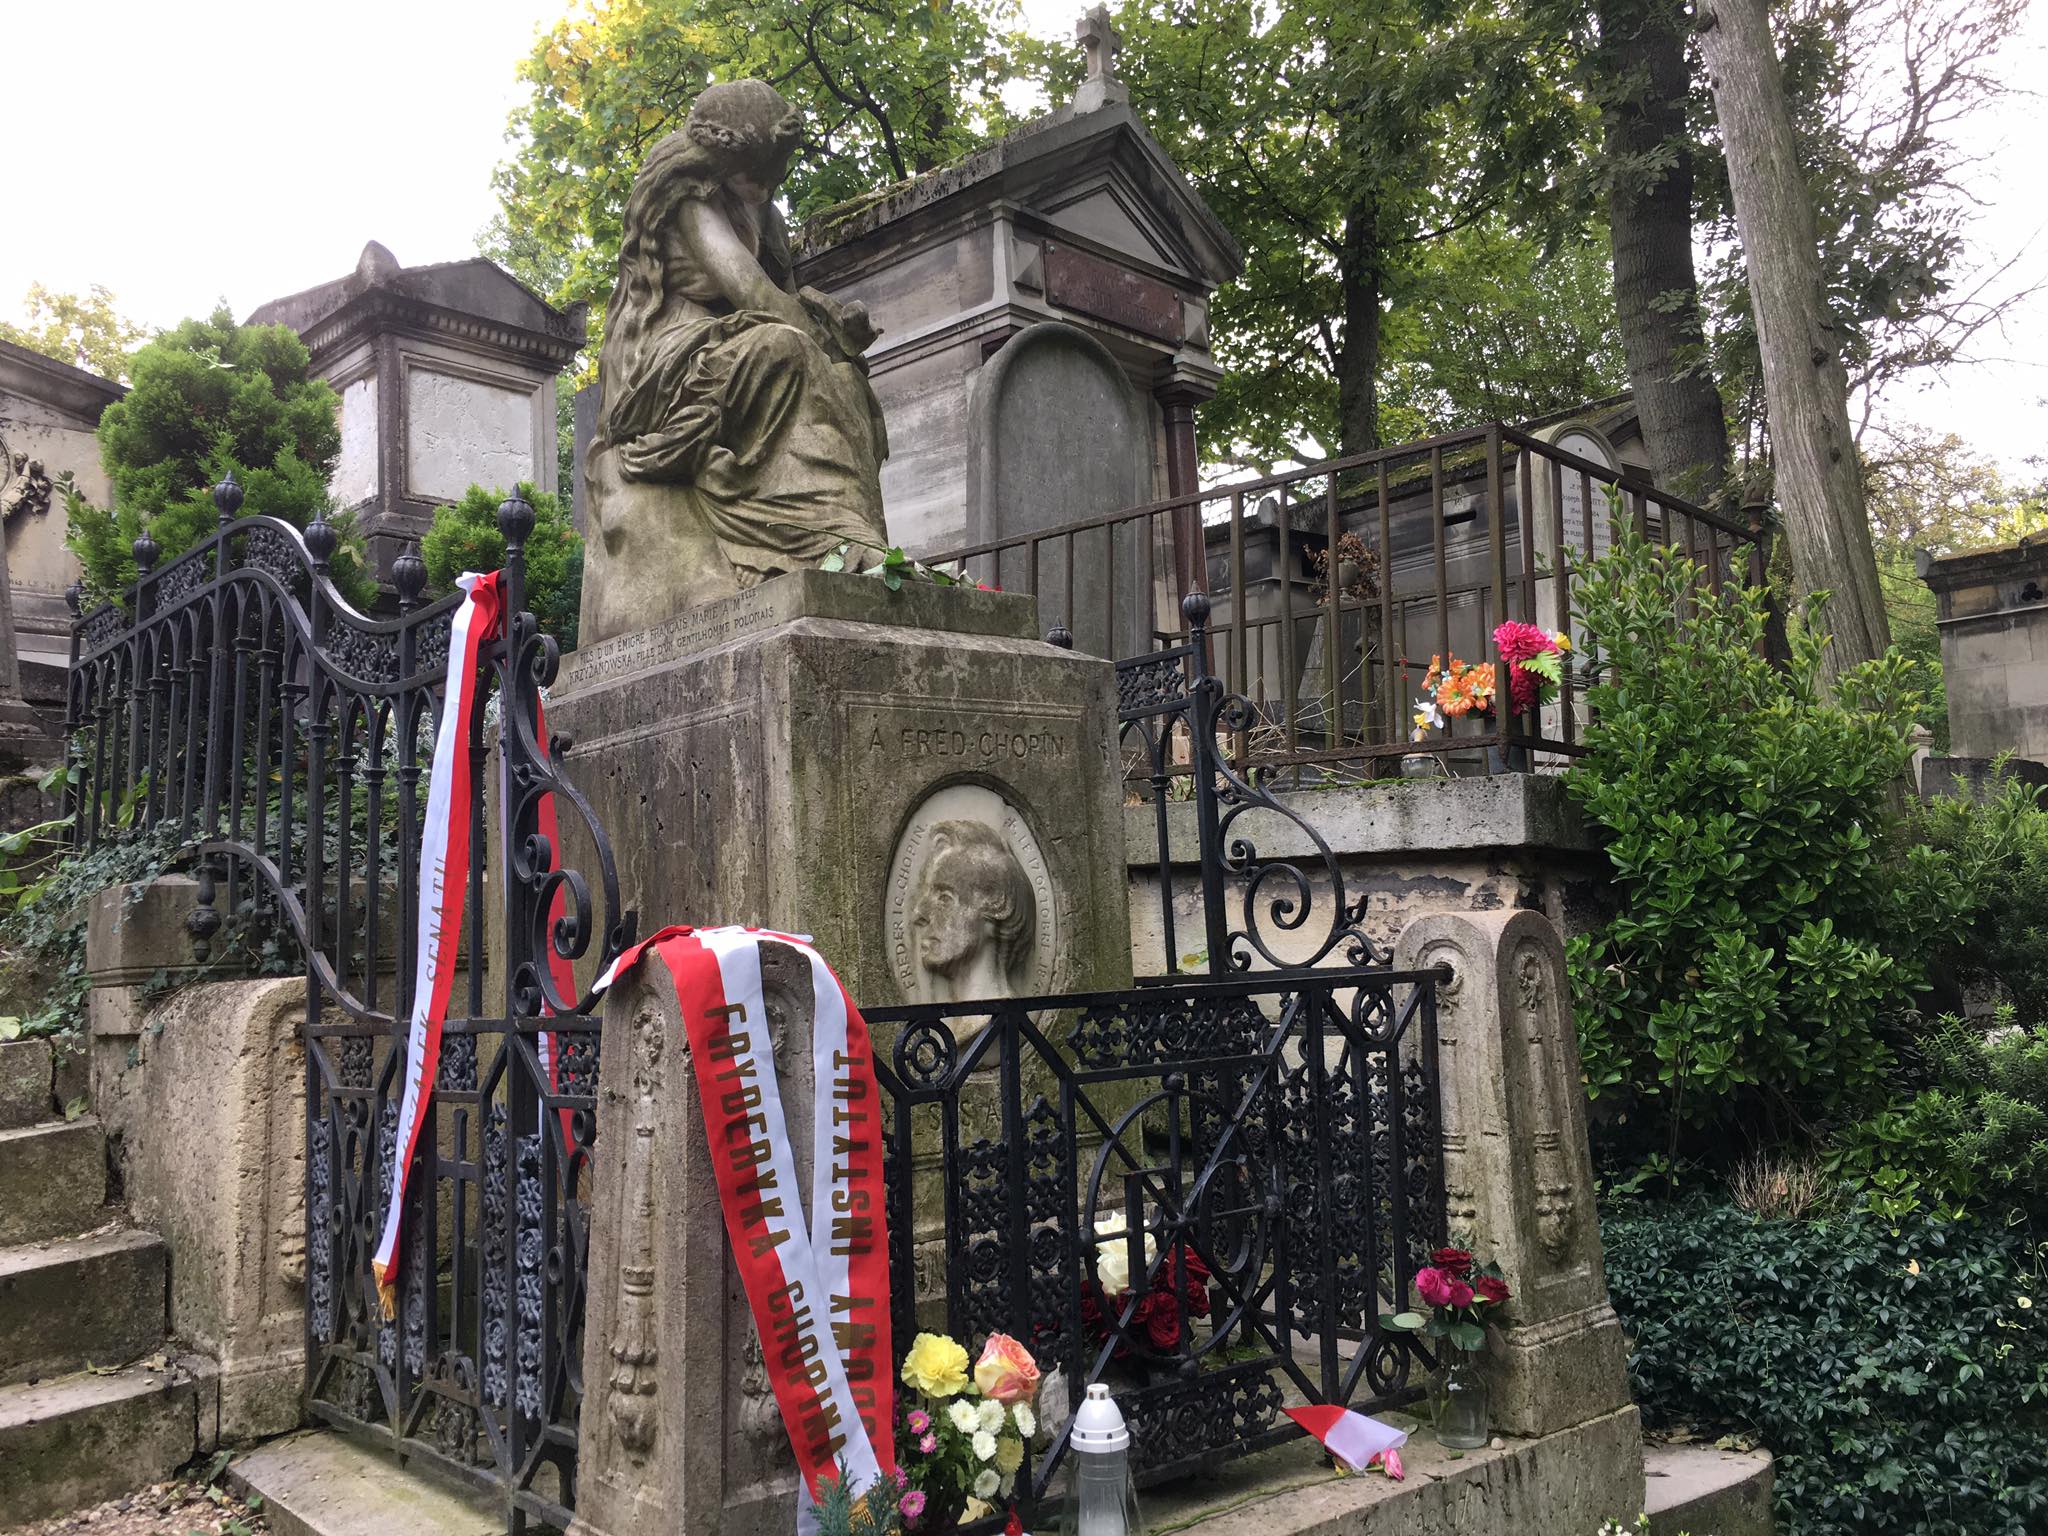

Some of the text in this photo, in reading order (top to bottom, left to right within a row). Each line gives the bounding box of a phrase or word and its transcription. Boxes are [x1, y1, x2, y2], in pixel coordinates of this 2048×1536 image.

[580, 645, 593, 665] FILS
[637, 645, 655, 662] FILLE
[677, 622, 731, 648] GENTILHOMME
[734, 606, 774, 630] POLONAIS
[979, 731, 1064, 758] CHOPIN
[831, 1049, 873, 1256] INSTYTUT
[704, 1002, 849, 1471] FRYDERYKA CHOPINA
